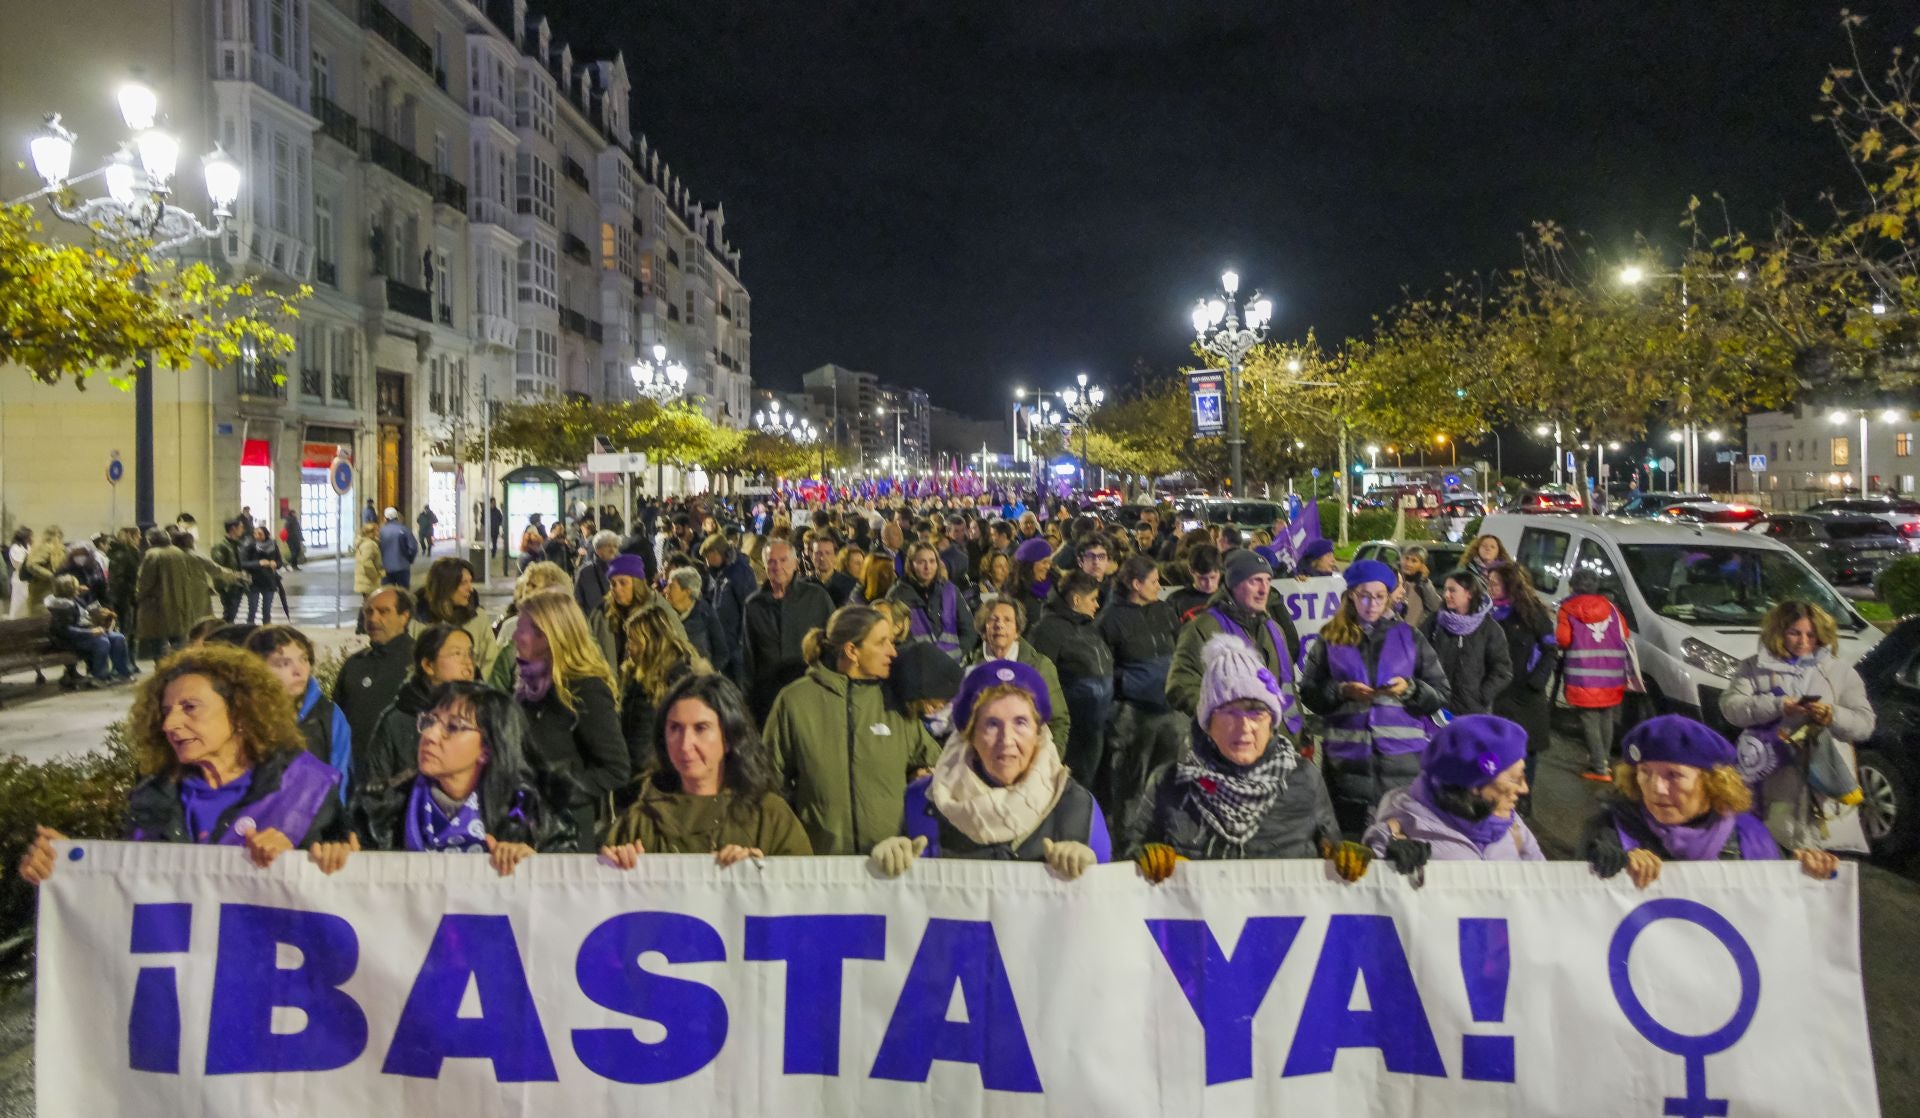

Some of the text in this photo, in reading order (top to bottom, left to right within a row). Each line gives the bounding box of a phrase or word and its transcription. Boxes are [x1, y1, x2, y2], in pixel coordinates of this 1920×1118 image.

[1282, 592, 1341, 621] STA
[129, 902, 1516, 1093] ¡BASTA YA!
